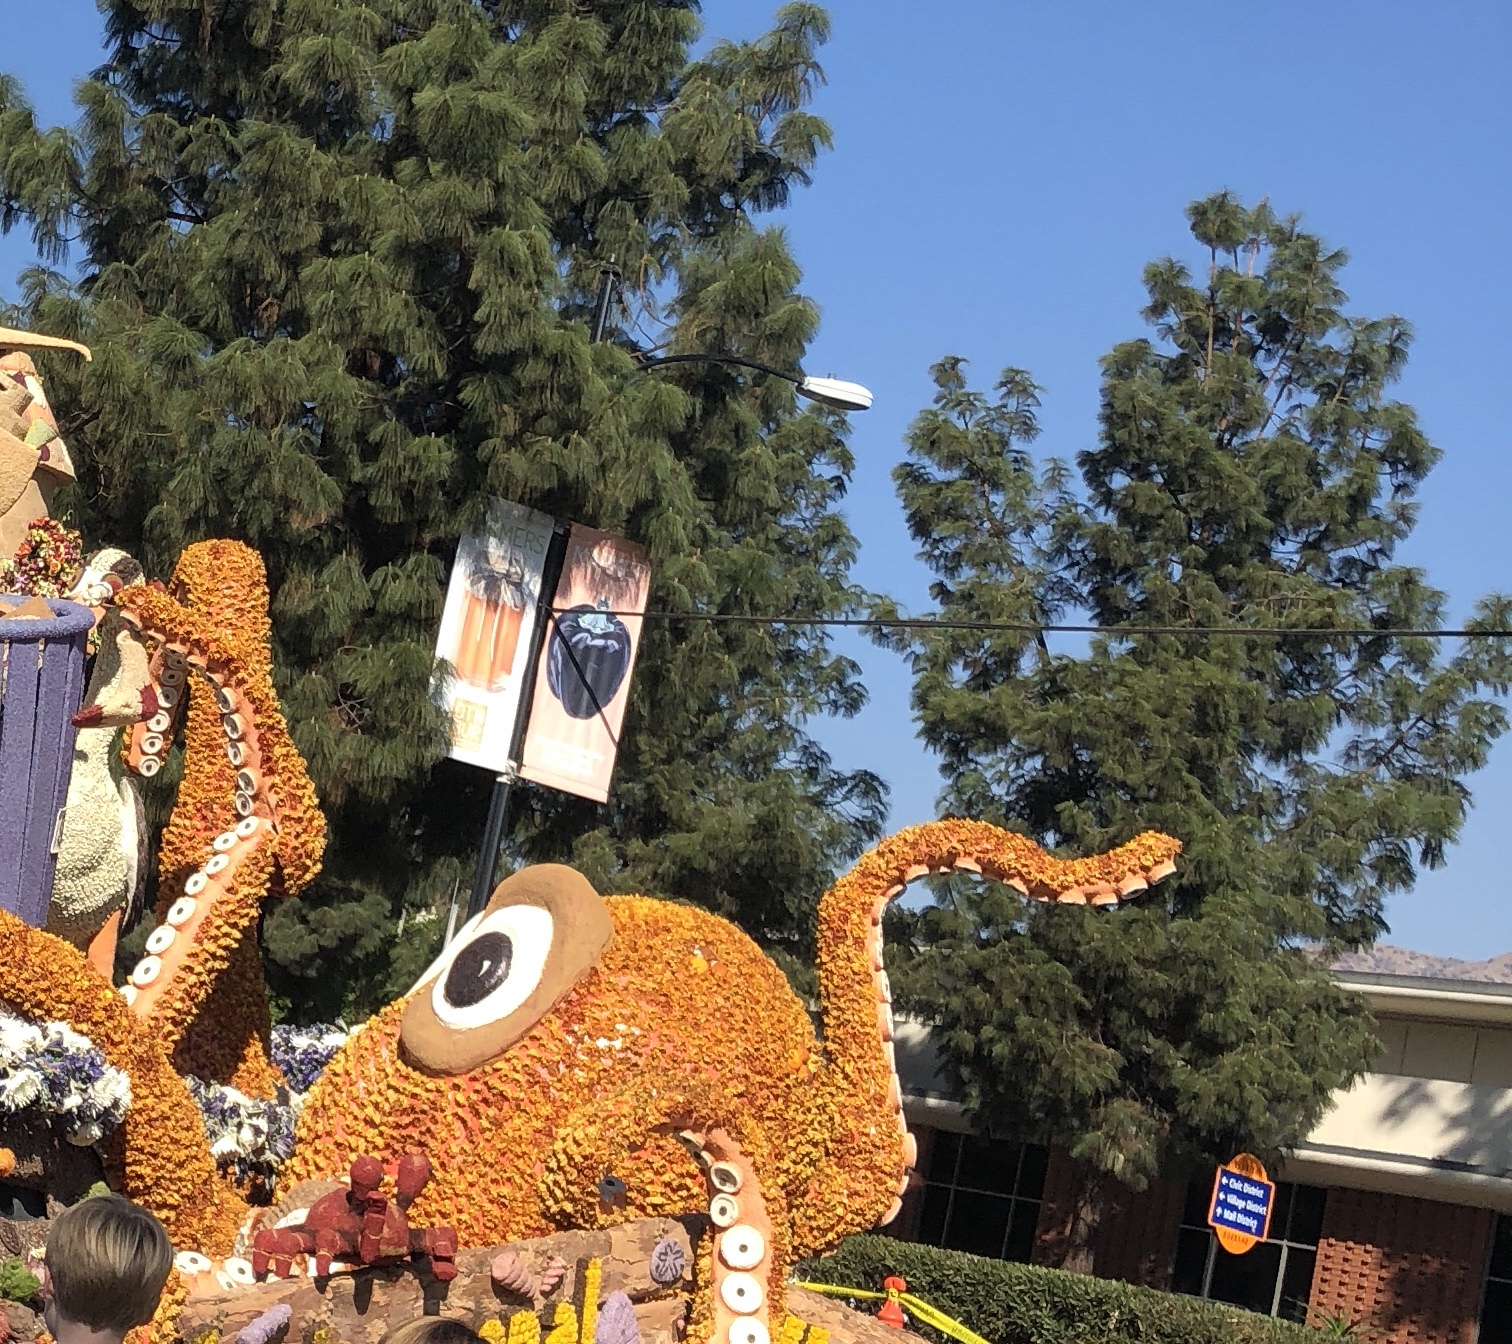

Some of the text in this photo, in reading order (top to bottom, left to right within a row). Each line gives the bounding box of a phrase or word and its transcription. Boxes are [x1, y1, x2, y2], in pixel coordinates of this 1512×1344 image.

[1243, 1182, 1264, 1199] District
[1246, 1199, 1267, 1216] District
[1236, 1212, 1258, 1230] District
